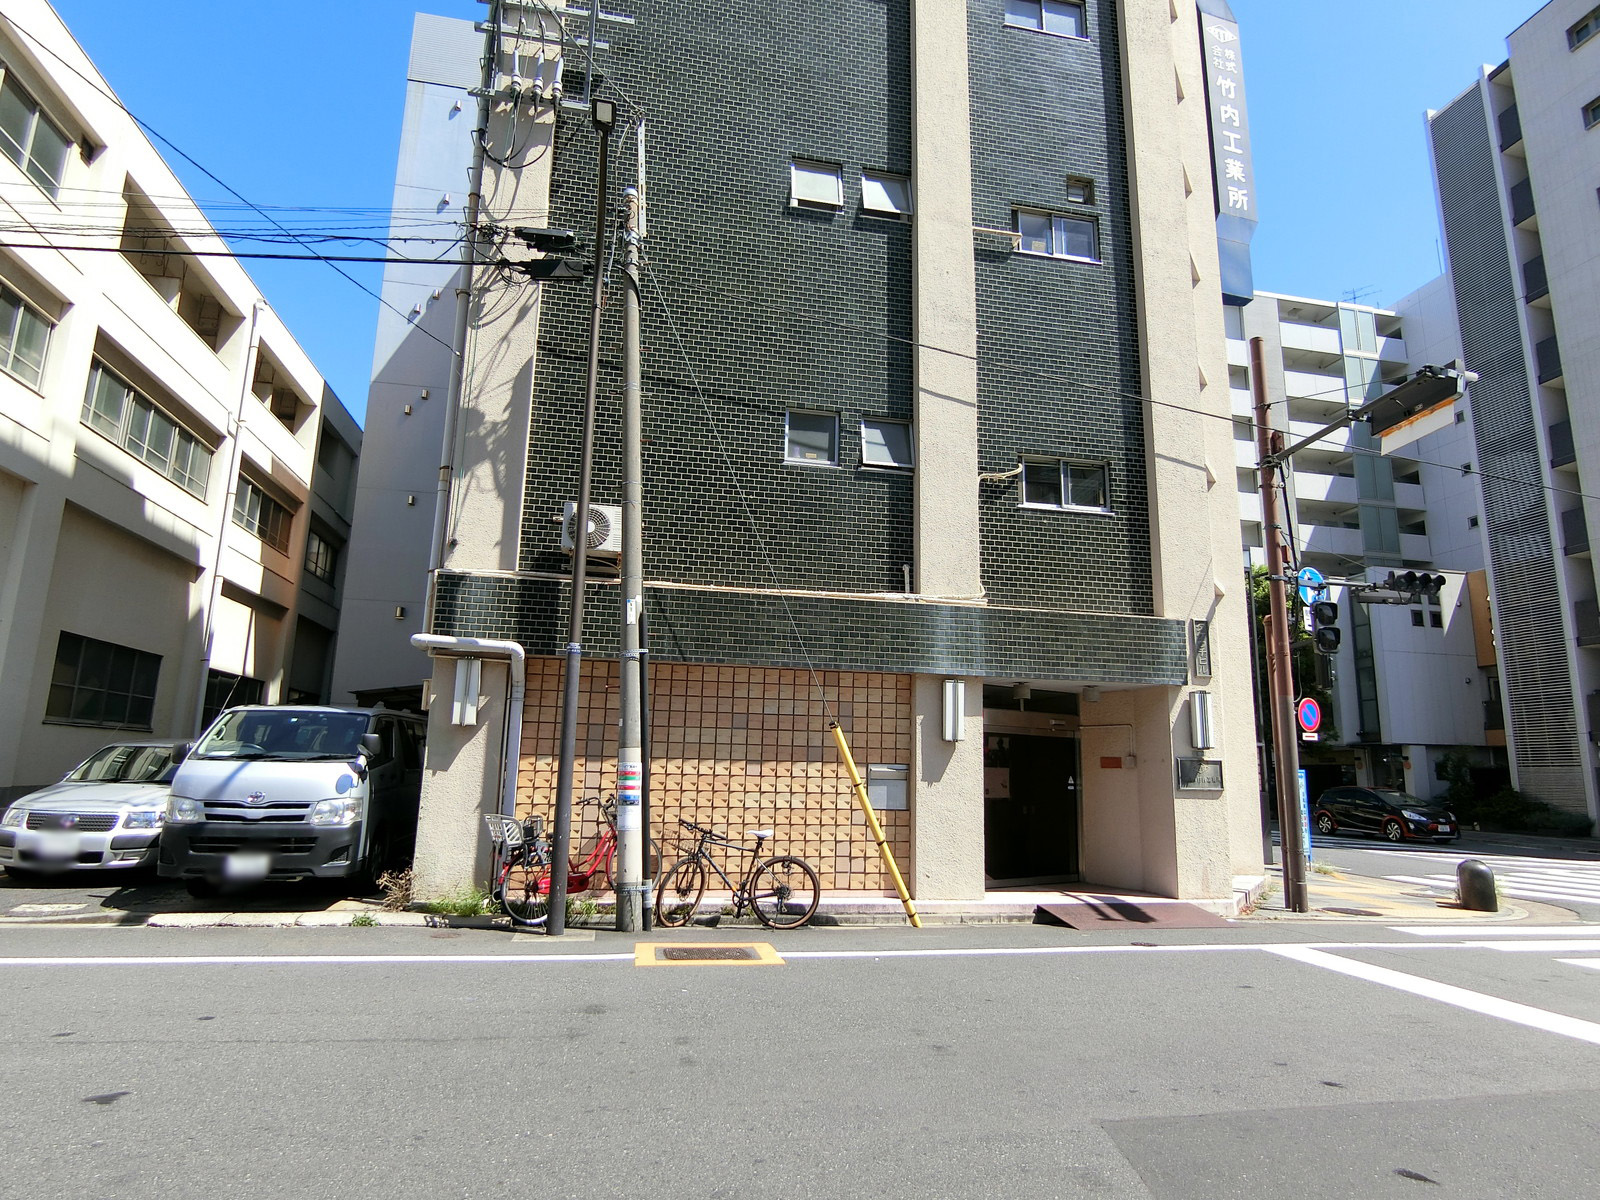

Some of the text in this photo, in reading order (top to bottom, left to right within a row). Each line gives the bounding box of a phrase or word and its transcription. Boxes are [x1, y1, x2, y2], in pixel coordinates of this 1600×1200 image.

[1211, 45, 1238, 74] 株式会社
[1216, 74, 1249, 211] 竹内工業所
